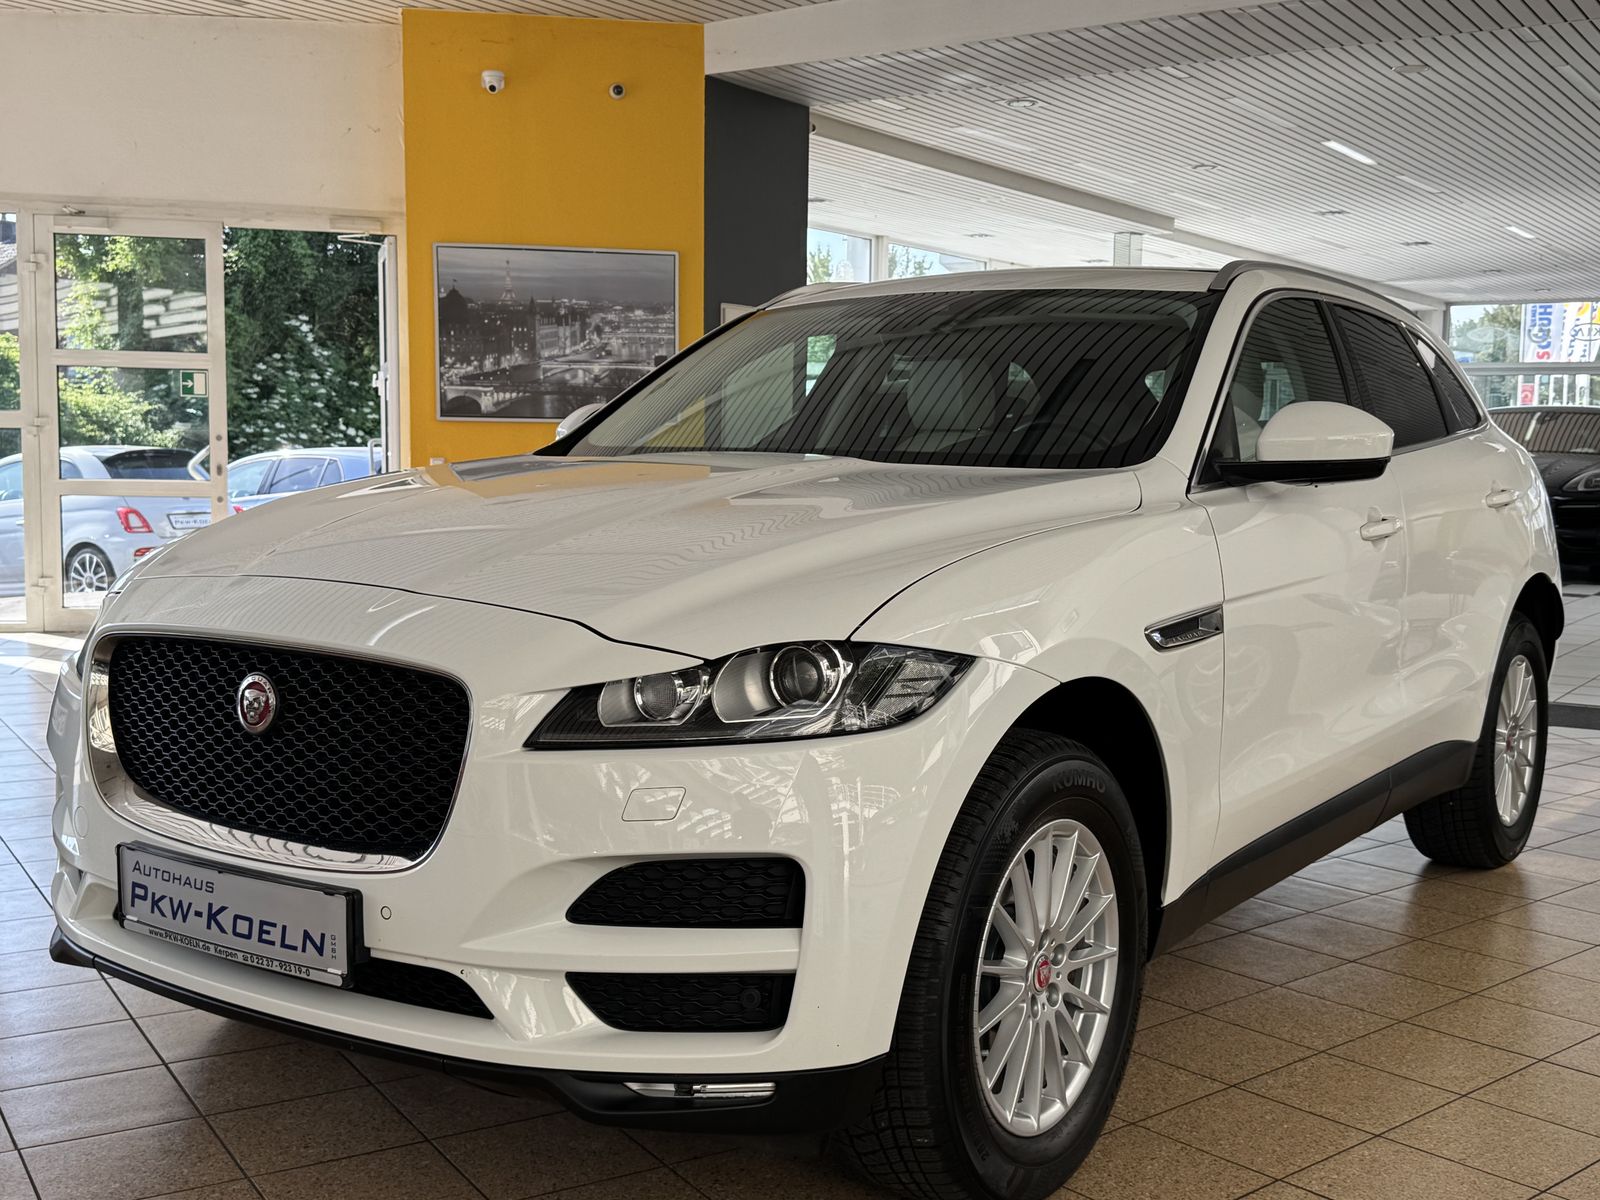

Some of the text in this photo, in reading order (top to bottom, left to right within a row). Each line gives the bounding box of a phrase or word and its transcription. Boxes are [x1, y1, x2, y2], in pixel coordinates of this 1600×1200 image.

[1053, 769, 1106, 794] KUMHO
[132, 859, 215, 894] AUTOHAUS
[130, 881, 326, 957] PKW-KOELN
[148, 928, 211, 953] www.PKW-KOELN.de
[213, 945, 239, 960] Kerpen
